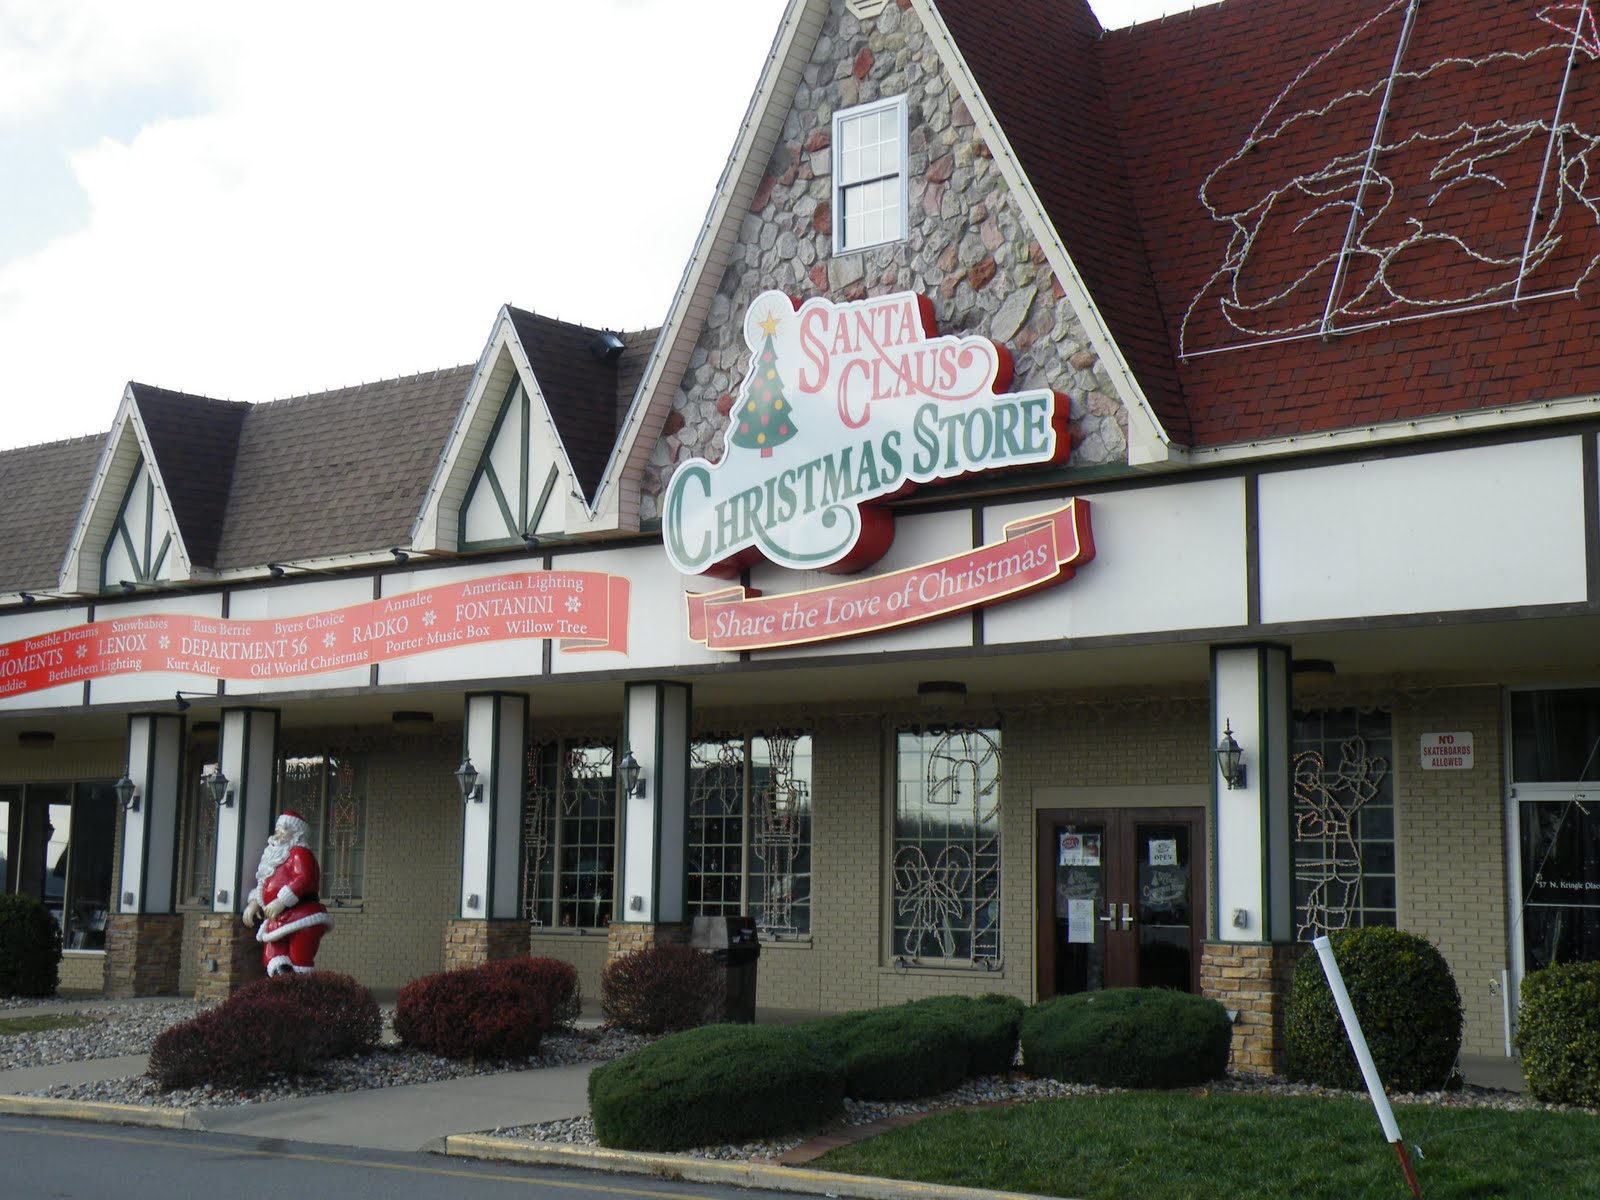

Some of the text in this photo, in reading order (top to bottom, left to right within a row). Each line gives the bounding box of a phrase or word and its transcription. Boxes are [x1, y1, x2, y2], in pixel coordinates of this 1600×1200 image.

[798, 301, 919, 394] SANTA
[837, 345, 958, 430] CLAUS
[667, 398, 1050, 569] CHRISTMAS STORE
[461, 575, 584, 597] American Lighting
[713, 543, 1048, 639] Share the Love of Christmas
[384, 593, 433, 613] Annalee
[455, 595, 553, 622] FONTANINI
[112, 618, 168, 633] Snowbabies
[193, 620, 251, 636] Russ Berrie
[274, 614, 345, 637] Byers Choice
[352, 616, 409, 644] RADKO
[505, 619, 587, 634] Willow Tree
[25, 628, 99, 652] Possible Dreams
[98, 634, 147, 656] LENOX
[181, 636, 308, 660] DEPARTMENT 56
[385, 625, 490, 653] Porter Music Box
[49, 657, 142, 682] Bethlehem Lighting
[166, 657, 220, 675] Kurt Adler
[251, 650, 369, 676] Old World Christmas
[0, 679, 27, 693] uddies
[1423, 745, 1471, 756] SKATEBOARDS
[1438, 735, 1455, 745] NO
[1431, 757, 1463, 767] ALLOWED
[1560, 881, 1583, 891] Kringle
[1584, 881, 1600, 890] Plac
